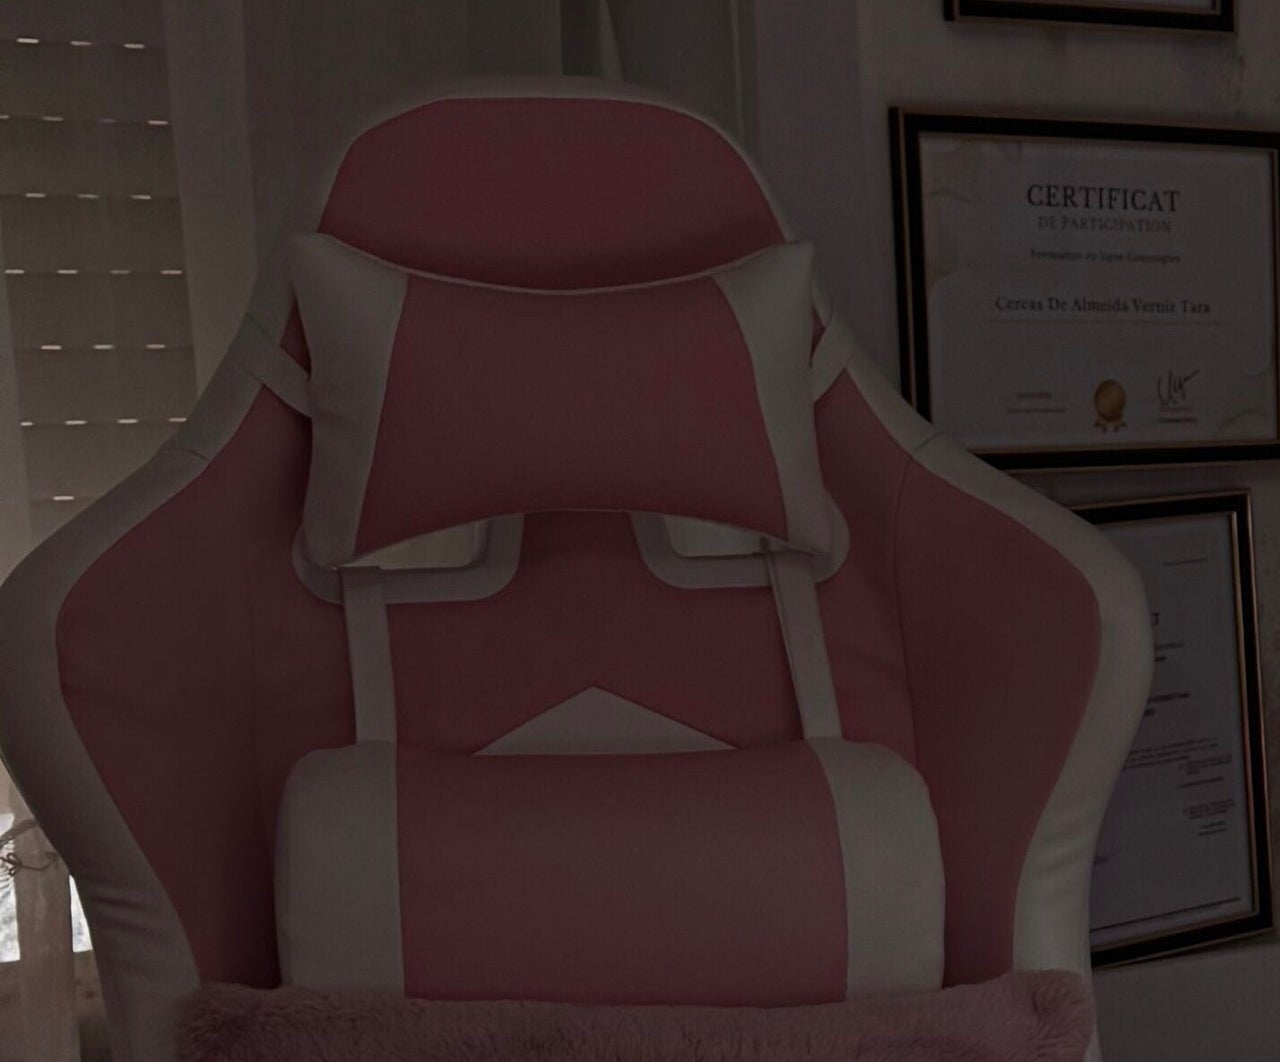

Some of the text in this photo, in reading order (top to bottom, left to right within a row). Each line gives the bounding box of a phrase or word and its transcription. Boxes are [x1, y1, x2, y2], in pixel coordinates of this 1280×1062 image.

[1026, 183, 1181, 212] CERTIFICAT
[1038, 216, 1172, 233] DE PARTICIPATION
[995, 296, 1044, 312] Cercas
[1048, 297, 1068, 313] De
[1071, 298, 1129, 313] Almeida
[1180, 299, 1211, 315] Tara
